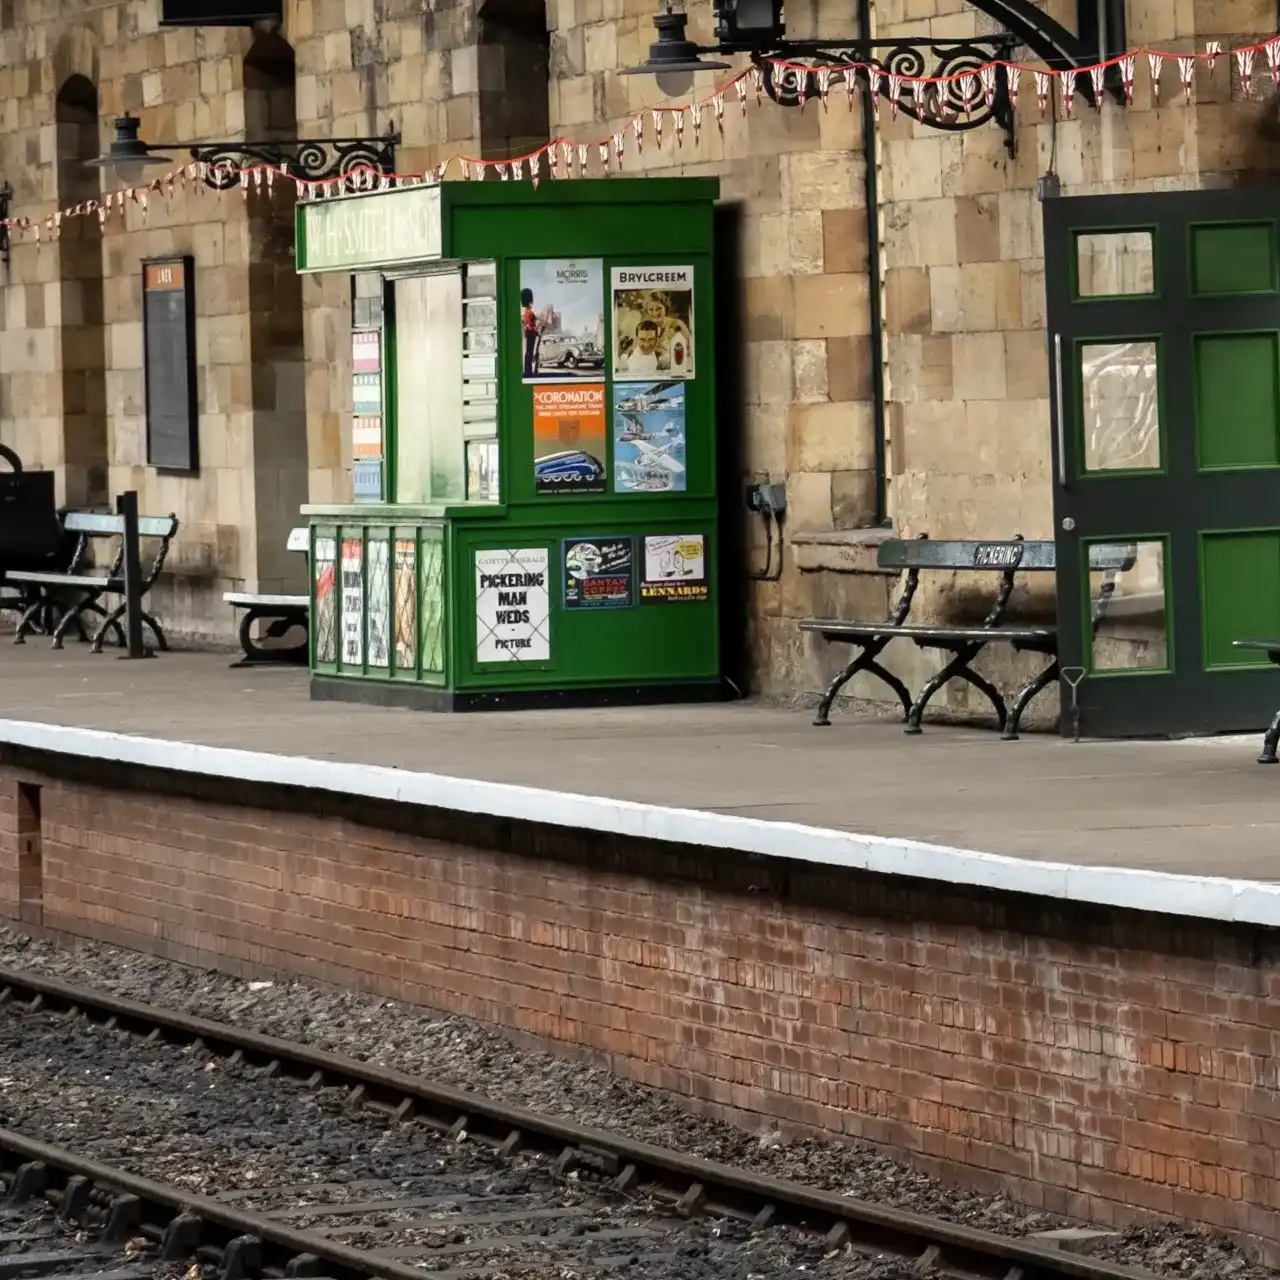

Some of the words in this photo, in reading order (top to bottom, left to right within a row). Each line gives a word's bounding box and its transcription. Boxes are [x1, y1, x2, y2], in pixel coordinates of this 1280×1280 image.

[556, 269, 588, 279] MORRIS
[620, 271, 687, 283] BRYLCREEM
[540, 390, 603, 403] CORONATION
[976, 546, 1018, 565] PICKERING
[480, 572, 545, 588] PICKERING
[584, 577, 628, 586] BANTAM
[642, 586, 708, 596] LENNARDS
[498, 592, 527, 606] MAN
[496, 610, 530, 625] WEDS
[495, 638, 532, 649] PICTURE
